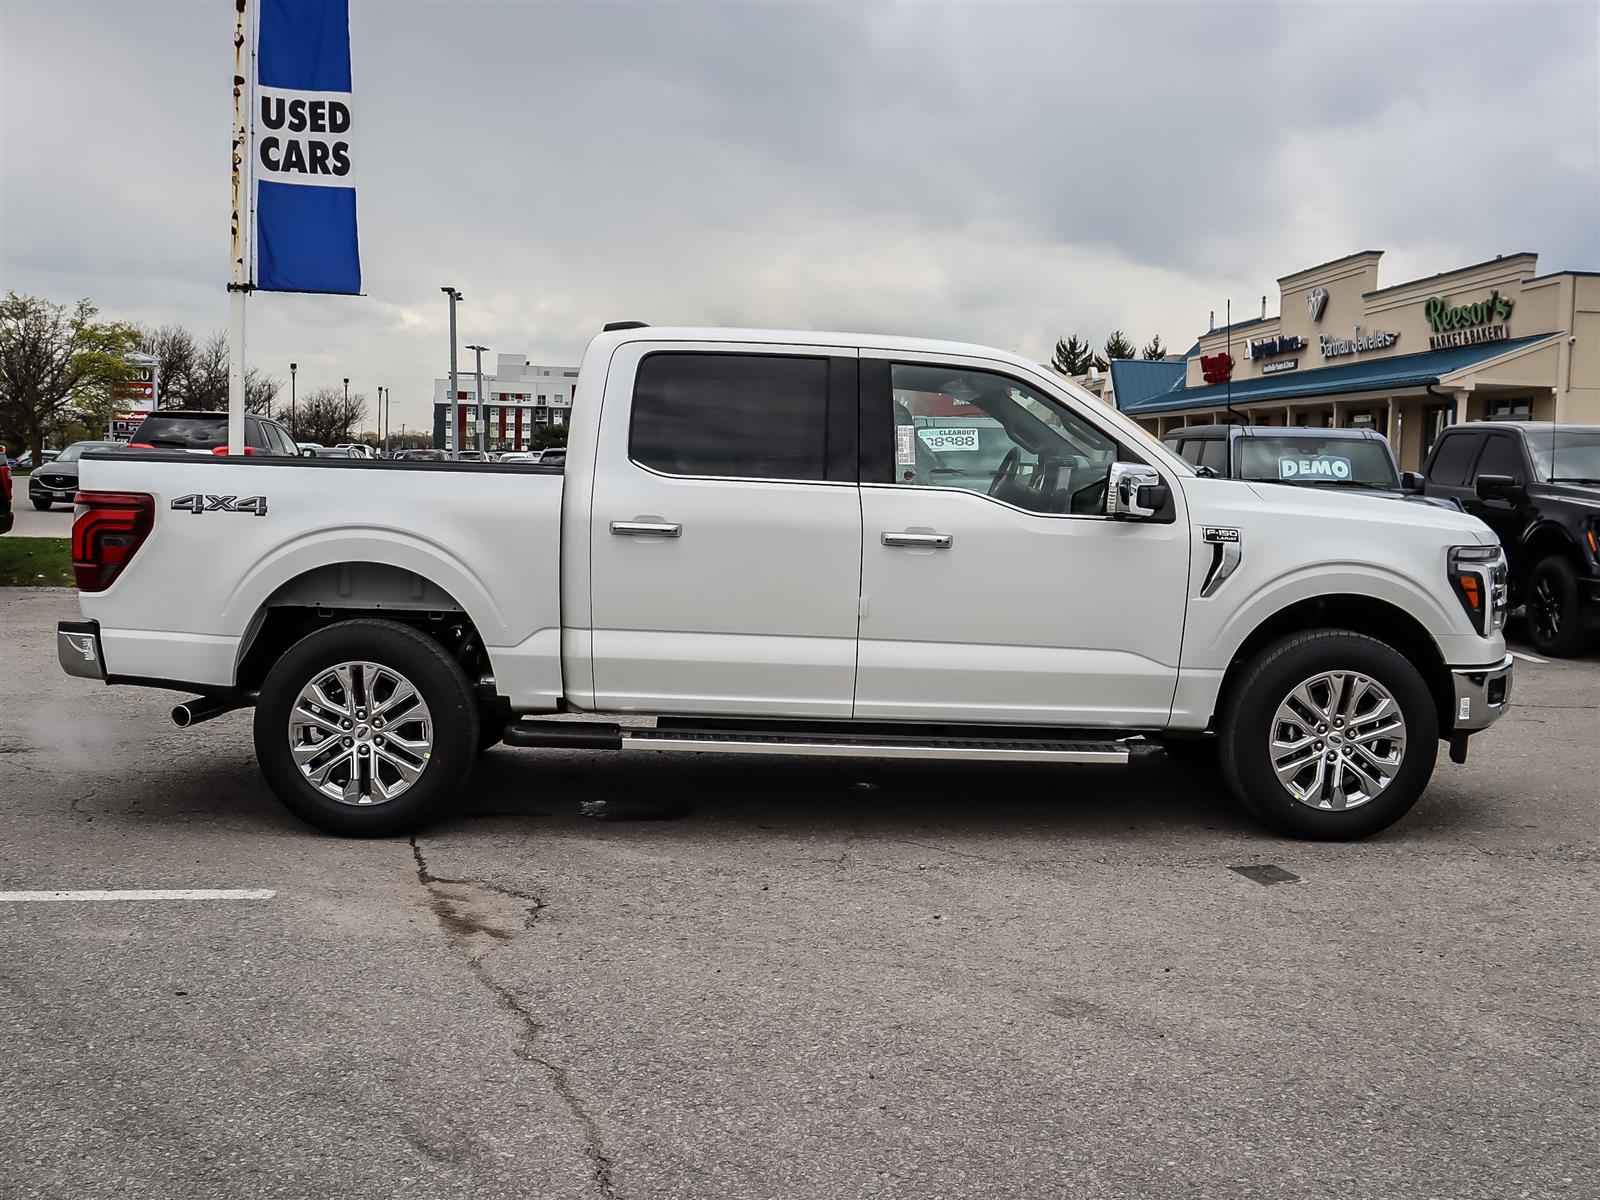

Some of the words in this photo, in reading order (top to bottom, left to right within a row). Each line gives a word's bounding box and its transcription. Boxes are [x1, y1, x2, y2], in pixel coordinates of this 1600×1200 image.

[261, 96, 351, 133] USED
[260, 136, 351, 176] CARS
[1425, 288, 1509, 333] Reesor's
[1352, 326, 1393, 352] Jewellers
[1282, 460, 1349, 478] DEMO
